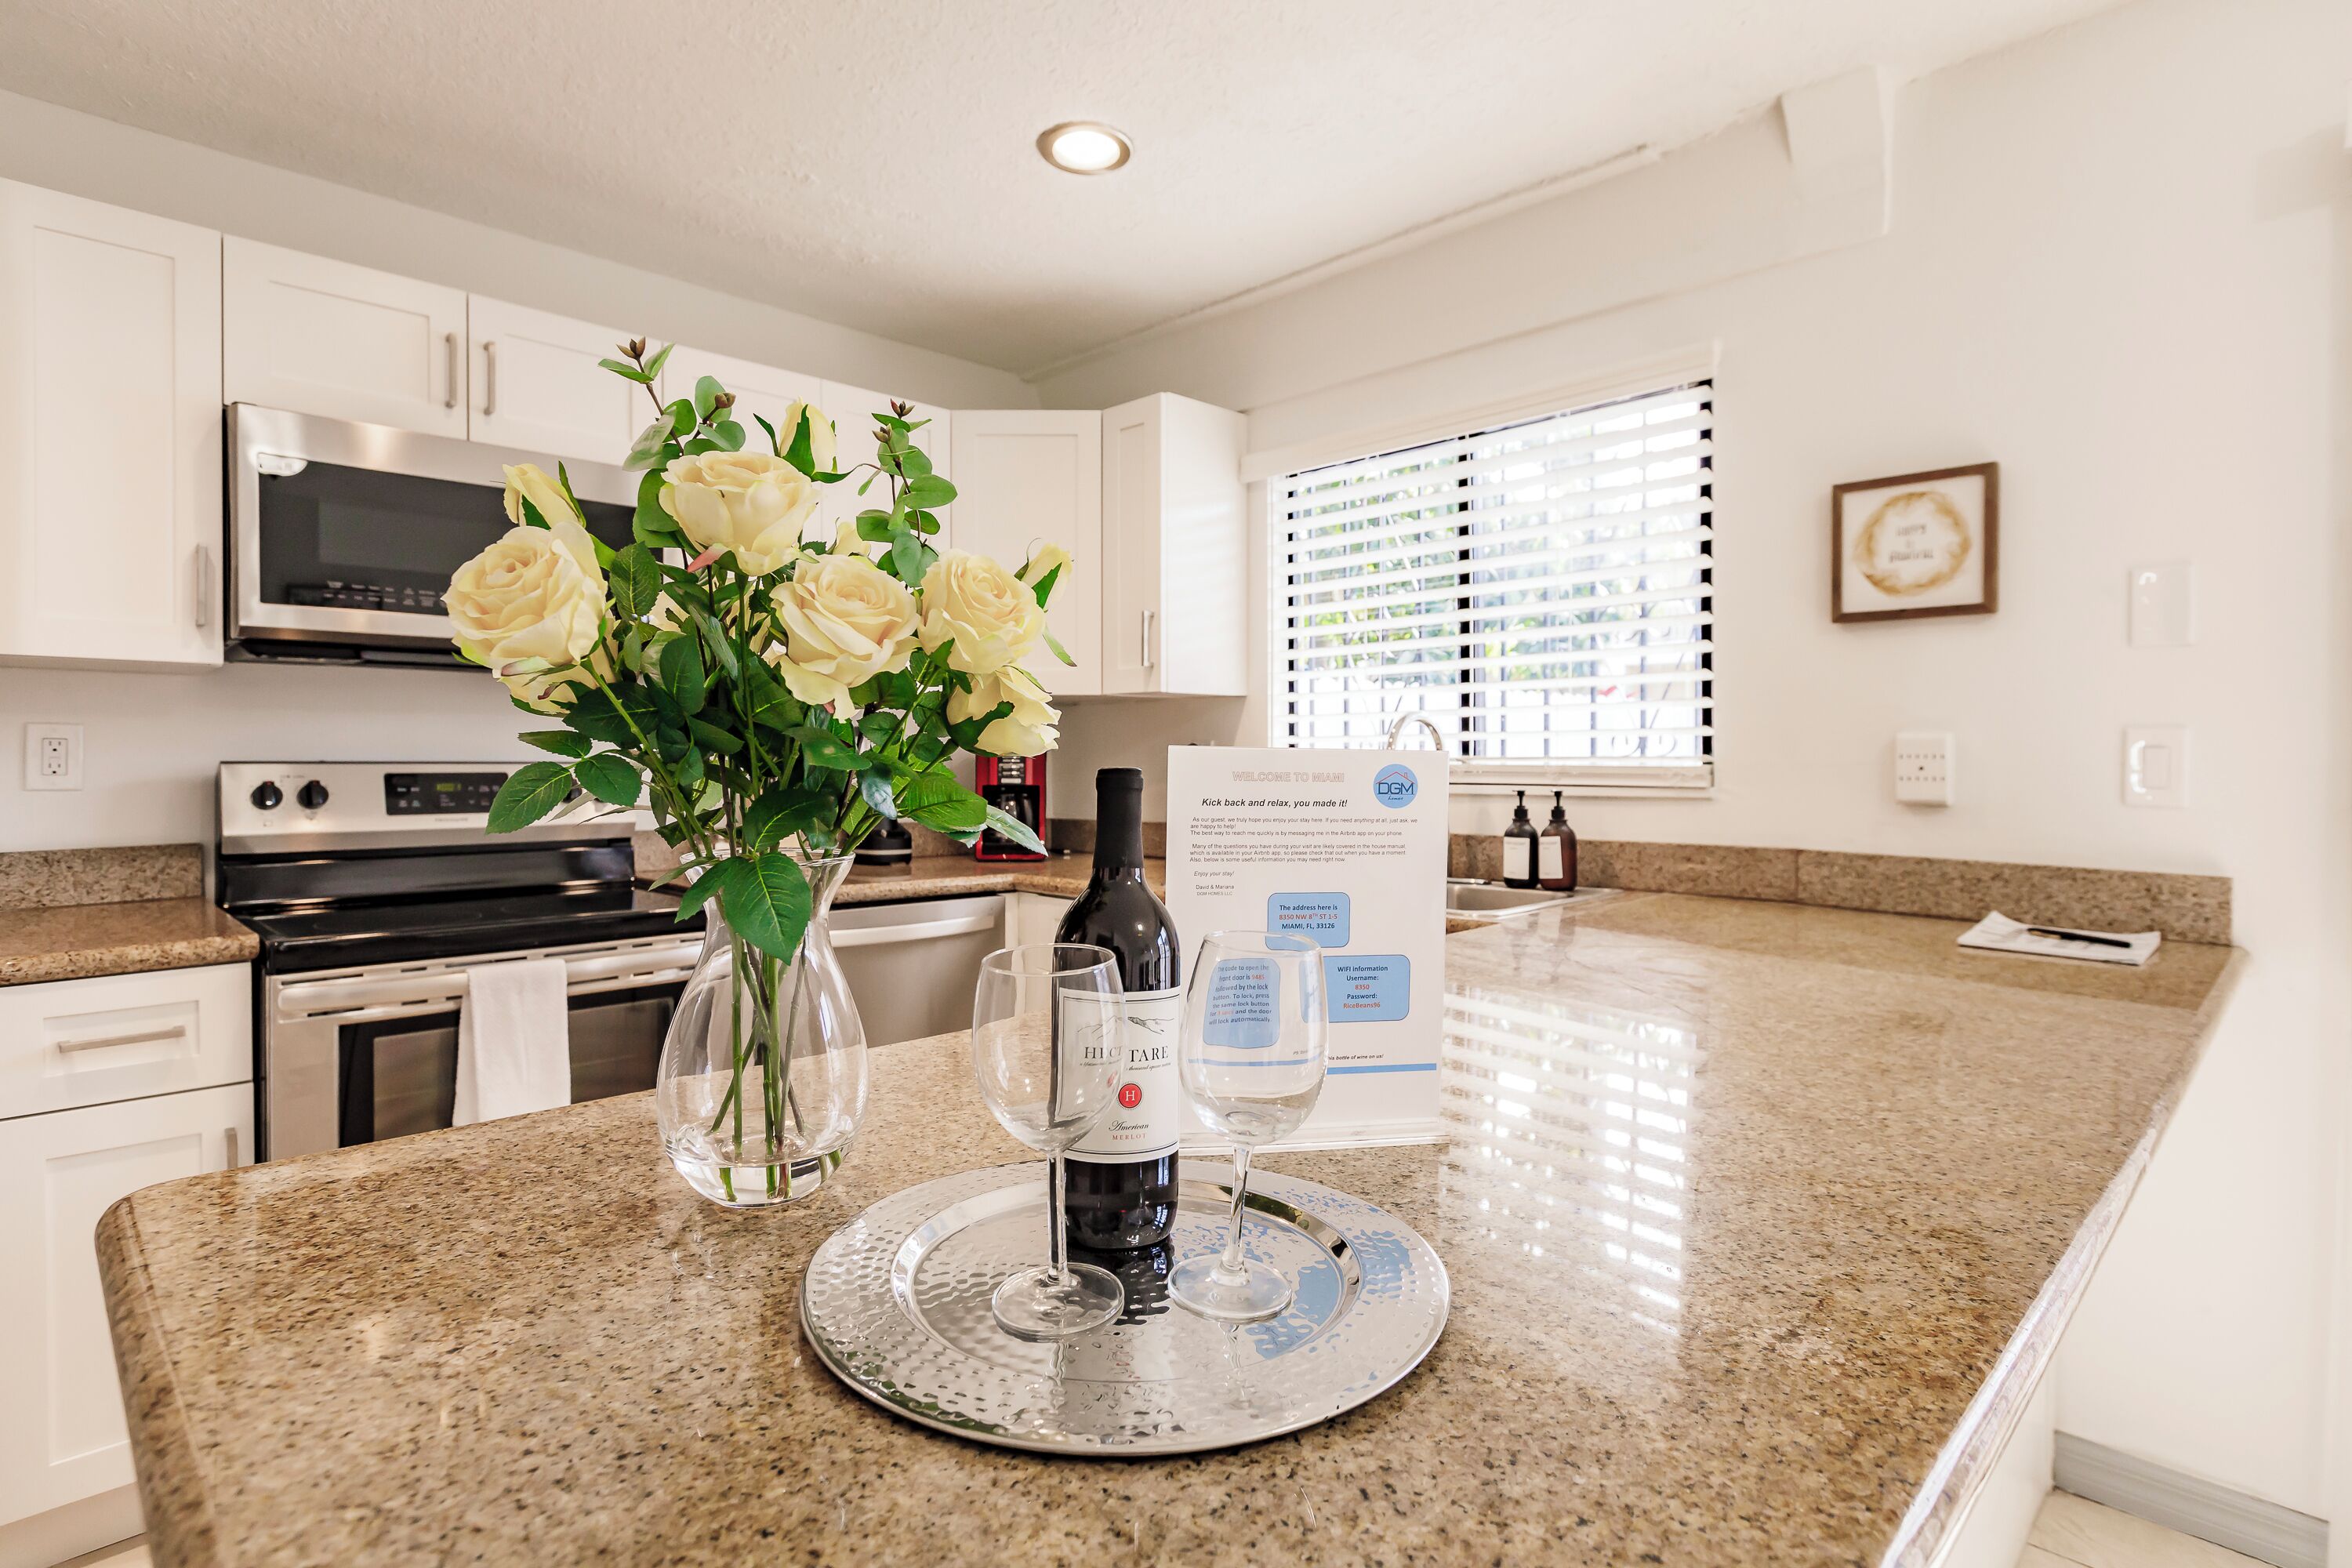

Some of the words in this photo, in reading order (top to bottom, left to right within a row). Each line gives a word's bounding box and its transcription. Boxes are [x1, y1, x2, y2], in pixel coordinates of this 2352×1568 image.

[1232, 771, 1291, 782] WELCOME
[1294, 772, 1308, 782] TO
[1312, 773, 1345, 782] MIAMI
[1378, 782, 1414, 795] DGM
[1267, 799, 1291, 808] relax,
[1125, 1090, 1135, 1101] H
[1109, 1120, 1149, 1131] American
